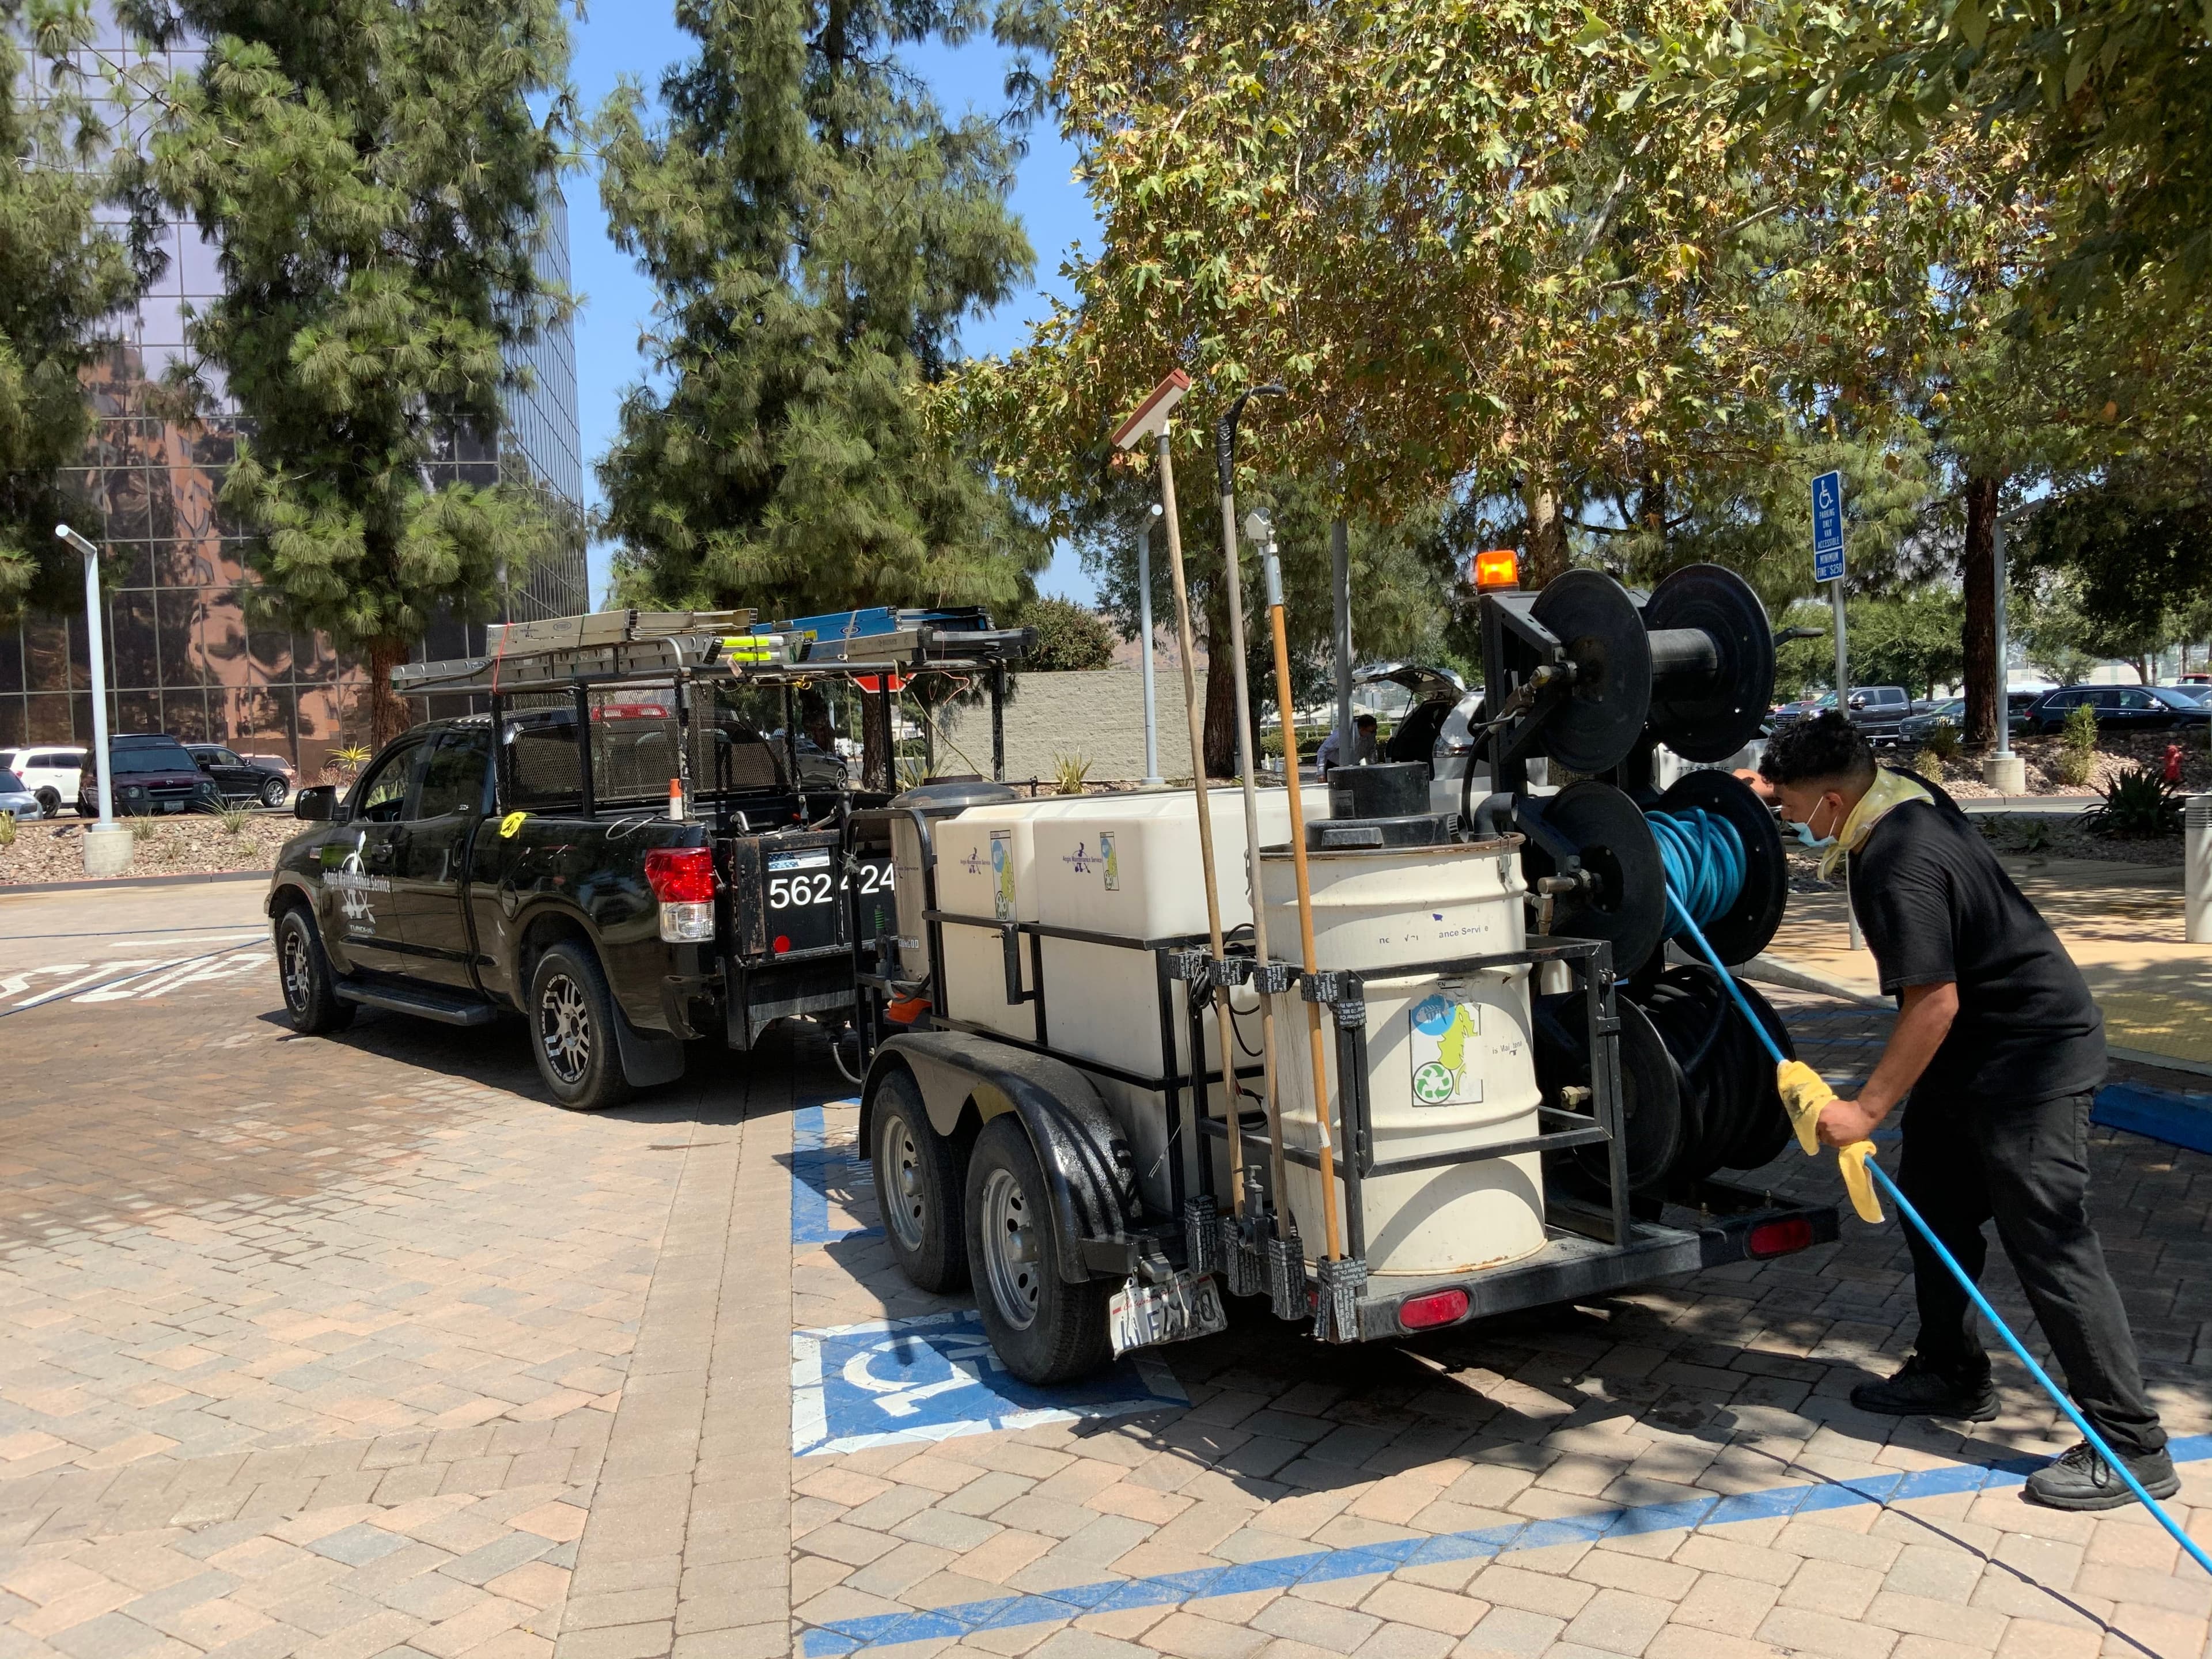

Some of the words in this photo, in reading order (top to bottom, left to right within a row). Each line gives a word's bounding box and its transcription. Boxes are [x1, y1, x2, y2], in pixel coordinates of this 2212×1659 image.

[1819, 508, 1835, 520] PARKING
[1823, 519, 1832, 528] ONLY
[1824, 529, 1832, 537] VAN
[1817, 536, 1840, 549] ACCESSIBLE
[1820, 551, 1839, 565] MINIMUM
[1817, 567, 1827, 577] FINE
[1830, 563, 1842, 575] $250
[770, 873, 833, 908] 562
[1461, 925, 1489, 935] Servie
